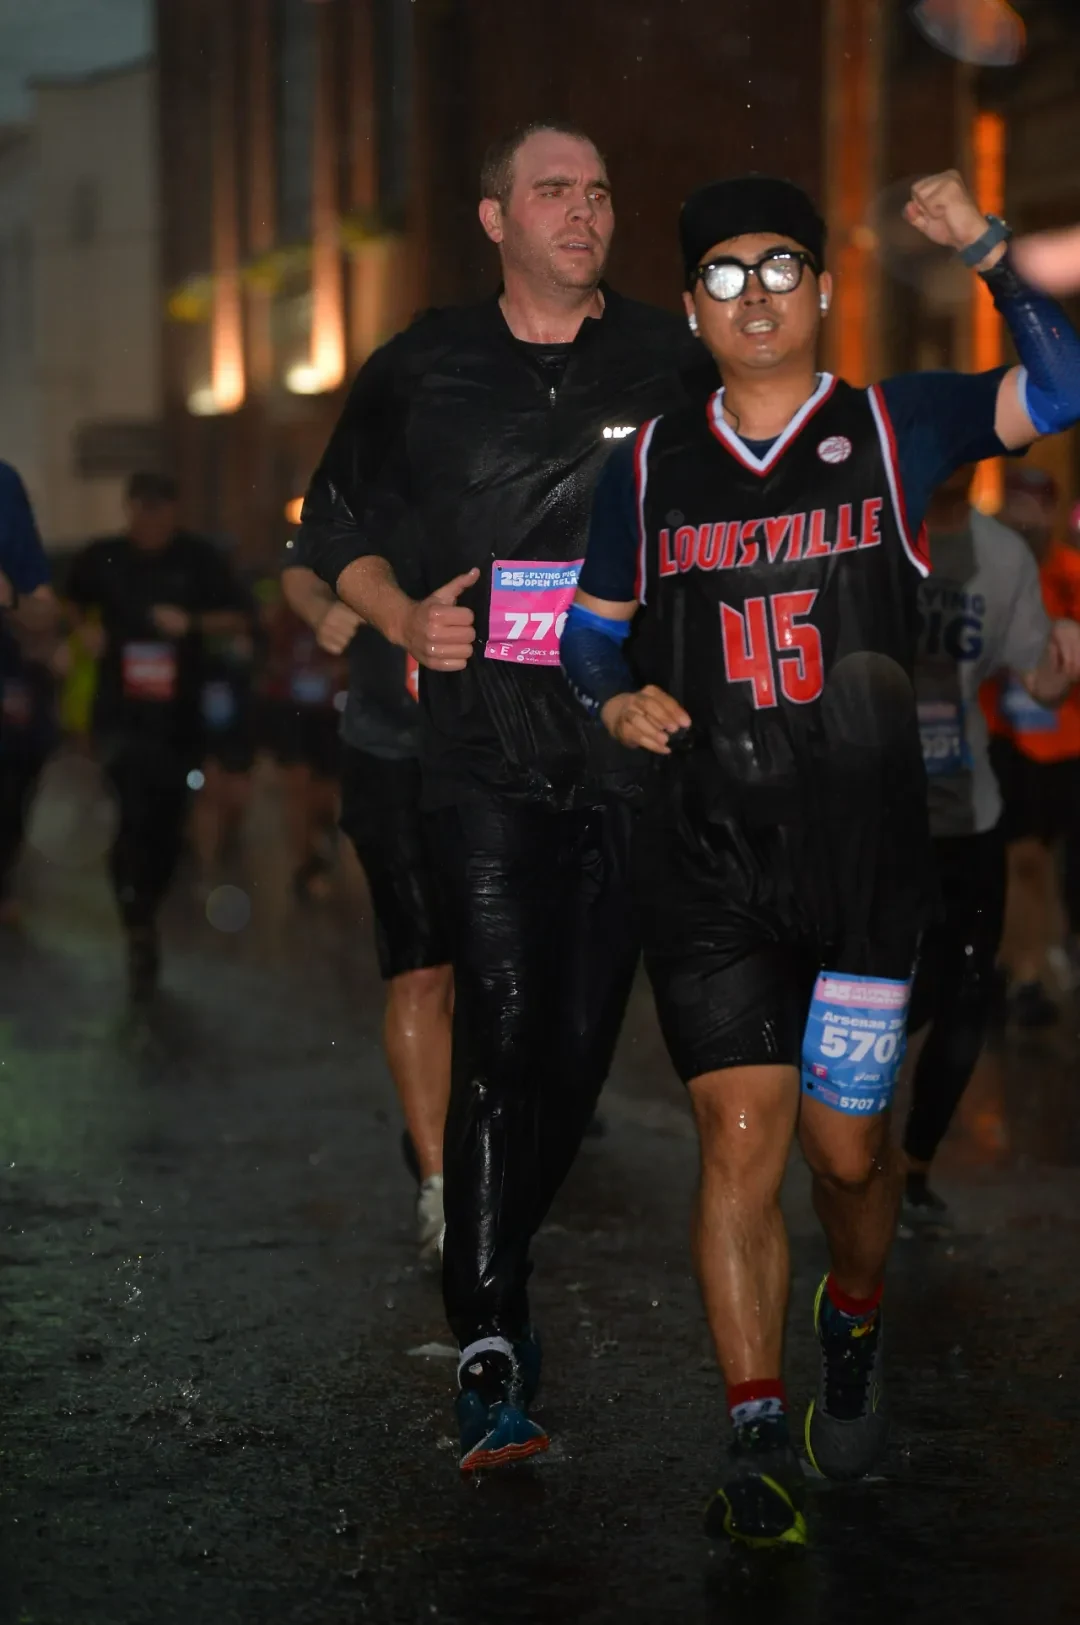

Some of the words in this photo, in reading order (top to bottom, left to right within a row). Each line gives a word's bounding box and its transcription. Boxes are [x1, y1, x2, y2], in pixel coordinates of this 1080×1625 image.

[658, 496, 883, 578] LOUISVILLE
[500, 571, 525, 587] 25
[524, 578, 551, 587] OPEN
[553, 576, 580, 587] RELA
[529, 572, 561, 580] FLYING
[500, 645, 509, 656] E
[718, 587, 825, 710] 45
[819, 1025, 904, 1064] 570
[840, 1096, 874, 1110] 5707
